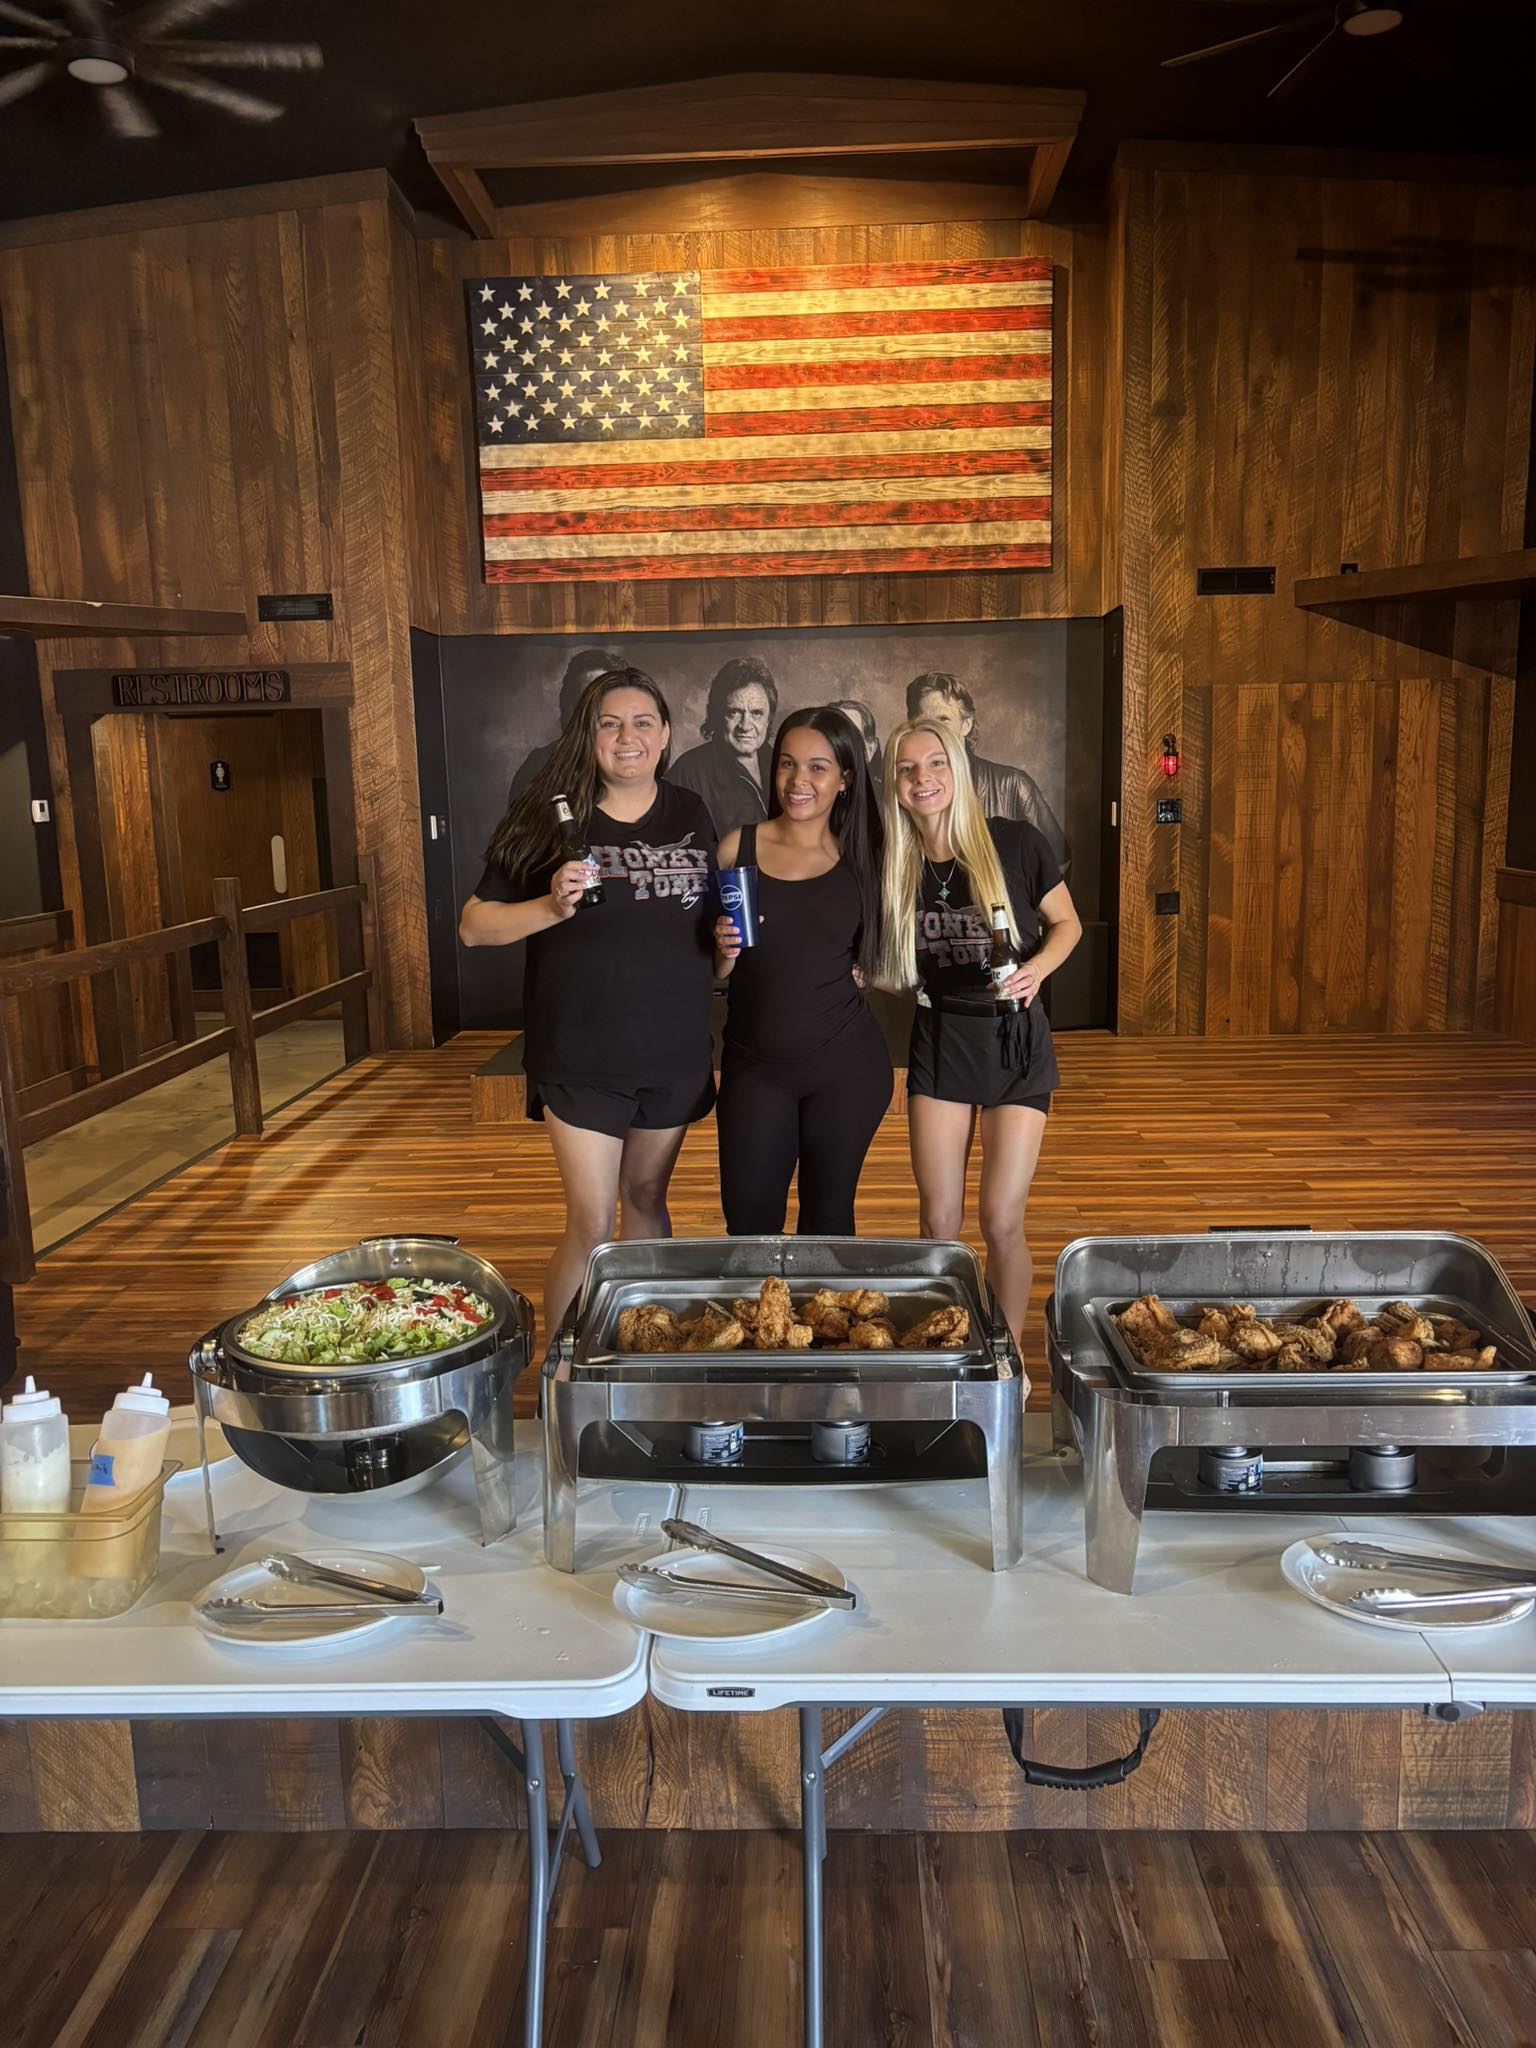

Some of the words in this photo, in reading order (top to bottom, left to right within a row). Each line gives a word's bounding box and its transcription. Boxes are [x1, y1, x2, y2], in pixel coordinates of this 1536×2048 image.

[118, 672, 283, 705] RESTROOMS
[590, 845, 708, 877] HONKY
[916, 911, 989, 950] ONK
[928, 939, 993, 968] TON
